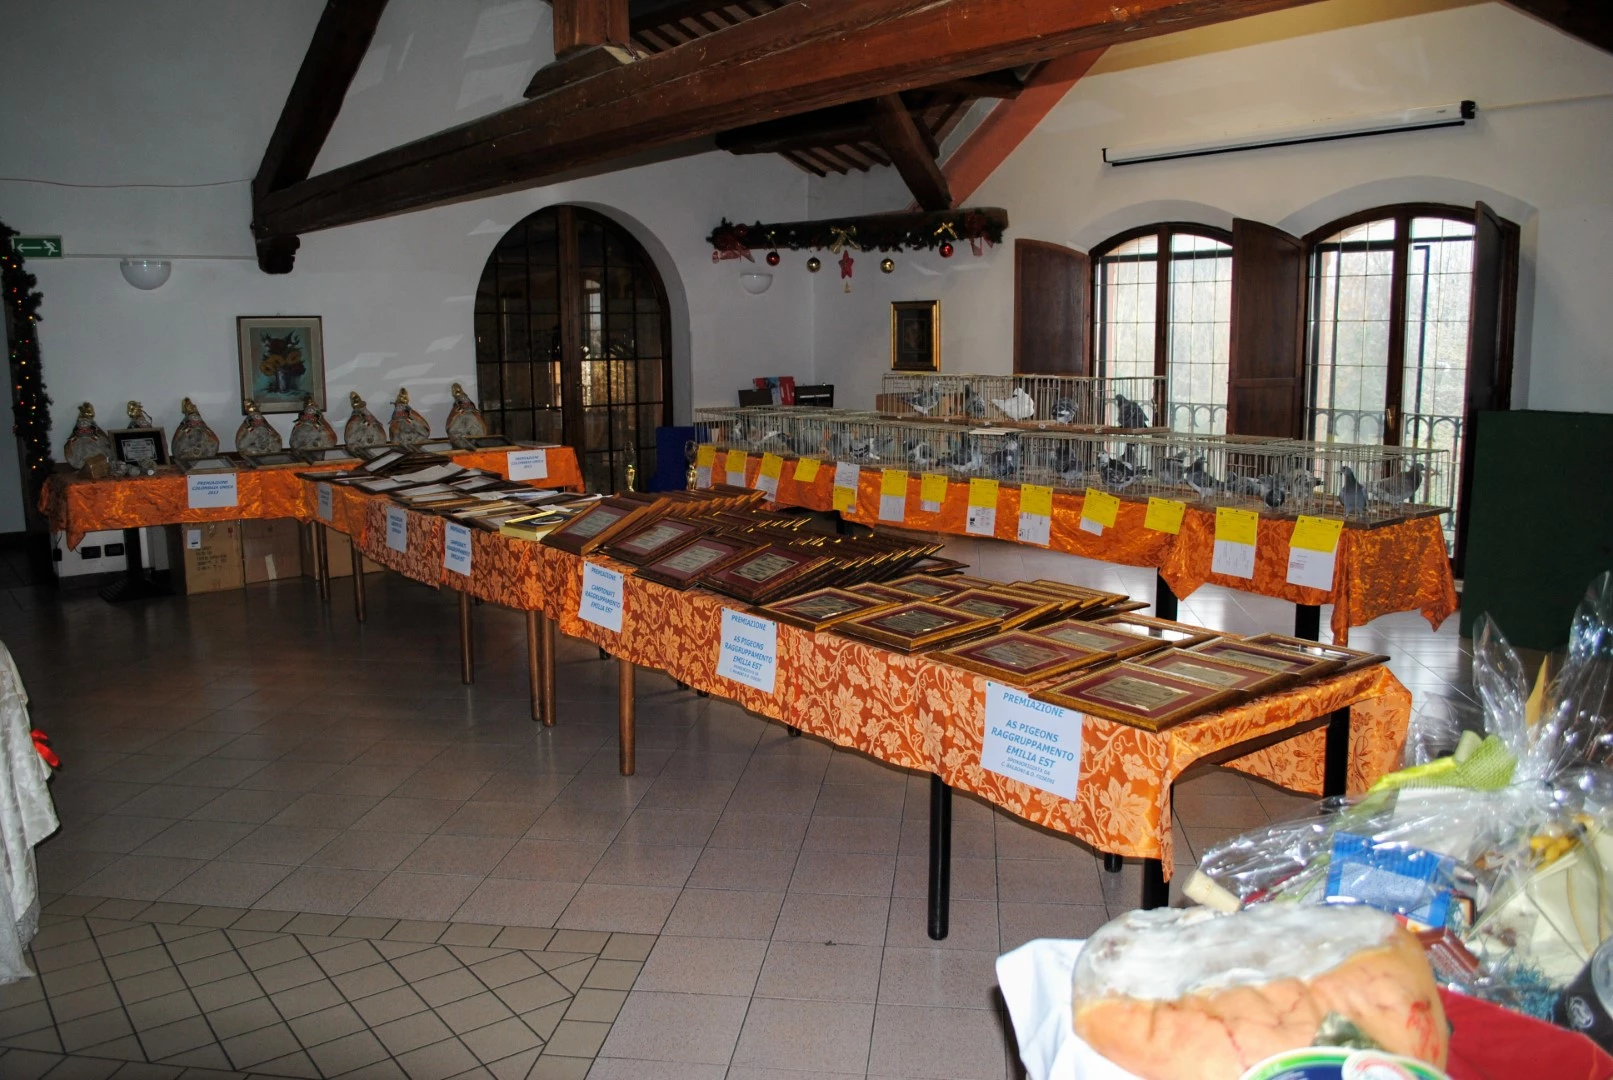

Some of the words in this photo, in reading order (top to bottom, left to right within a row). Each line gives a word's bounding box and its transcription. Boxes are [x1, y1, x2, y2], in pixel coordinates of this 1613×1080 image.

[731, 614, 767, 631] PREMIAZIONE
[724, 642, 773, 664] RAGGRUPPAMENTO
[740, 638, 764, 650] PIGEONS
[732, 656, 752, 667] EMILIA
[752, 662, 762, 670] EST
[1003, 692, 1064, 718] PREMIAZIONE
[1006, 720, 1018, 729] AS
[1018, 723, 1059, 743] PIGEONS
[991, 726, 1074, 762] RAGGRUPPAMENTO
[1006, 745, 1037, 762] EMILIA
[1038, 756, 1056, 768] EST
